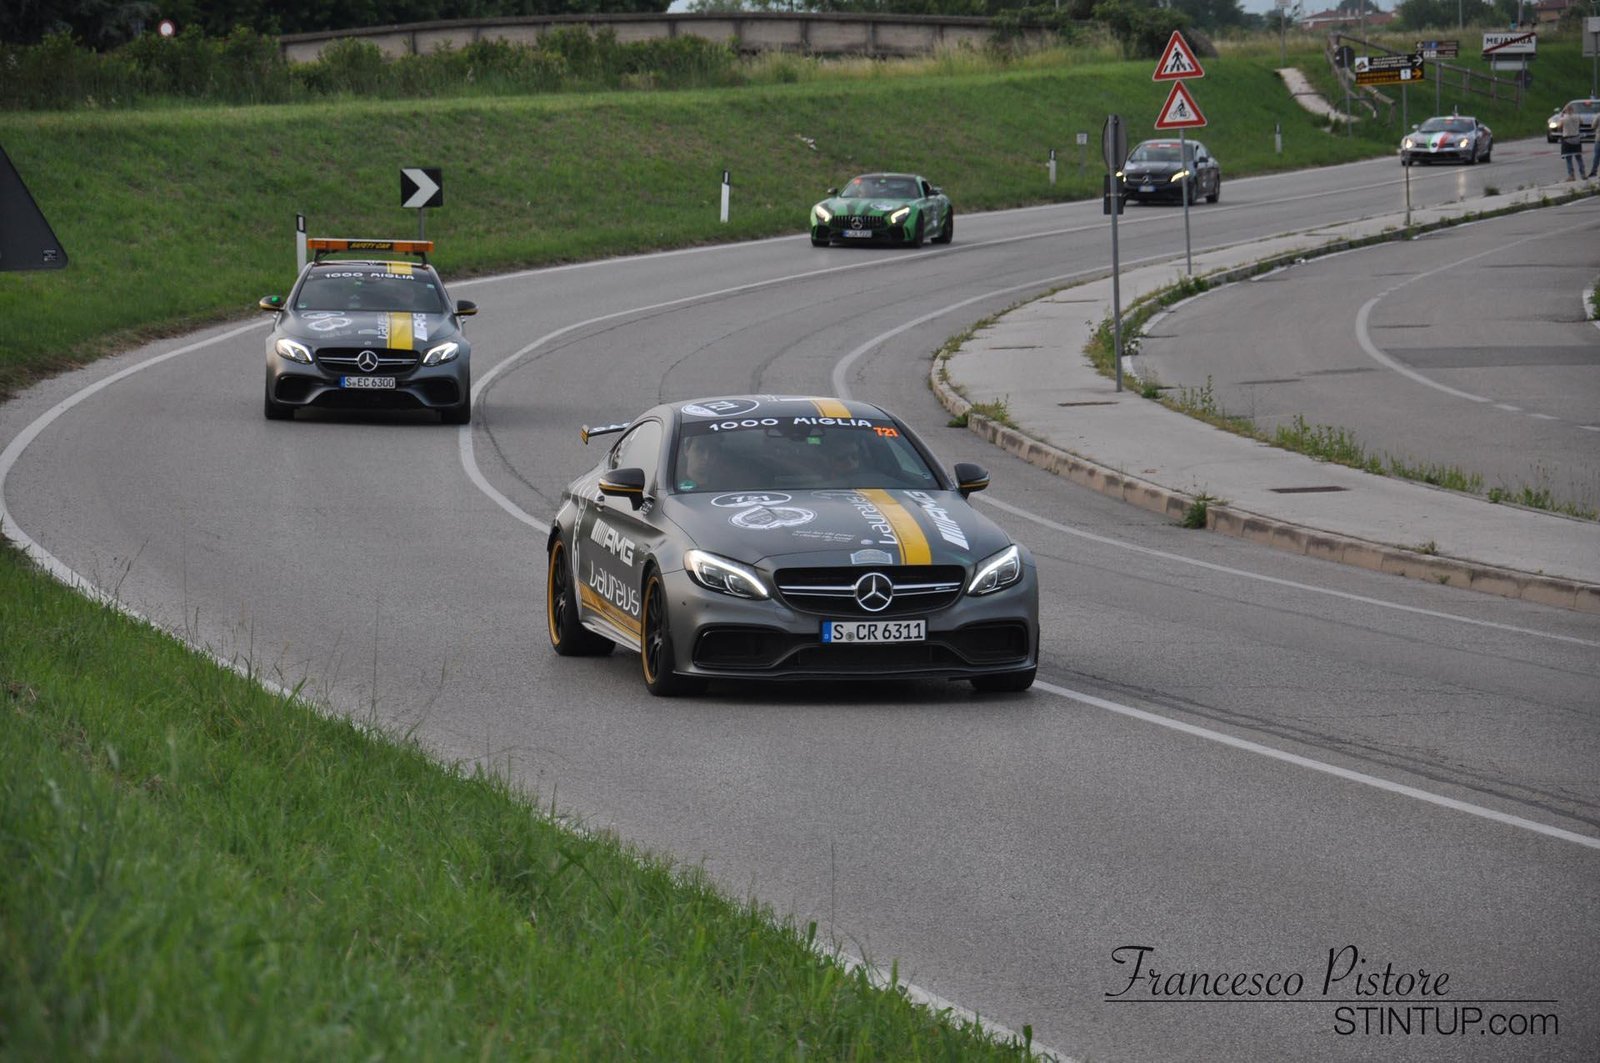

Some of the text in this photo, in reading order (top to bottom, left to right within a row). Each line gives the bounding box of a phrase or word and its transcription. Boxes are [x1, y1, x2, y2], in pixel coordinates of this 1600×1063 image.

[346, 378, 394, 387] S EC 6300
[709, 417, 873, 431] 1000 MIGLIA
[873, 426, 899, 437] 721
[594, 520, 636, 567] AMG
[833, 624, 844, 640] S
[856, 624, 878, 640] CR
[882, 622, 923, 640] 6311
